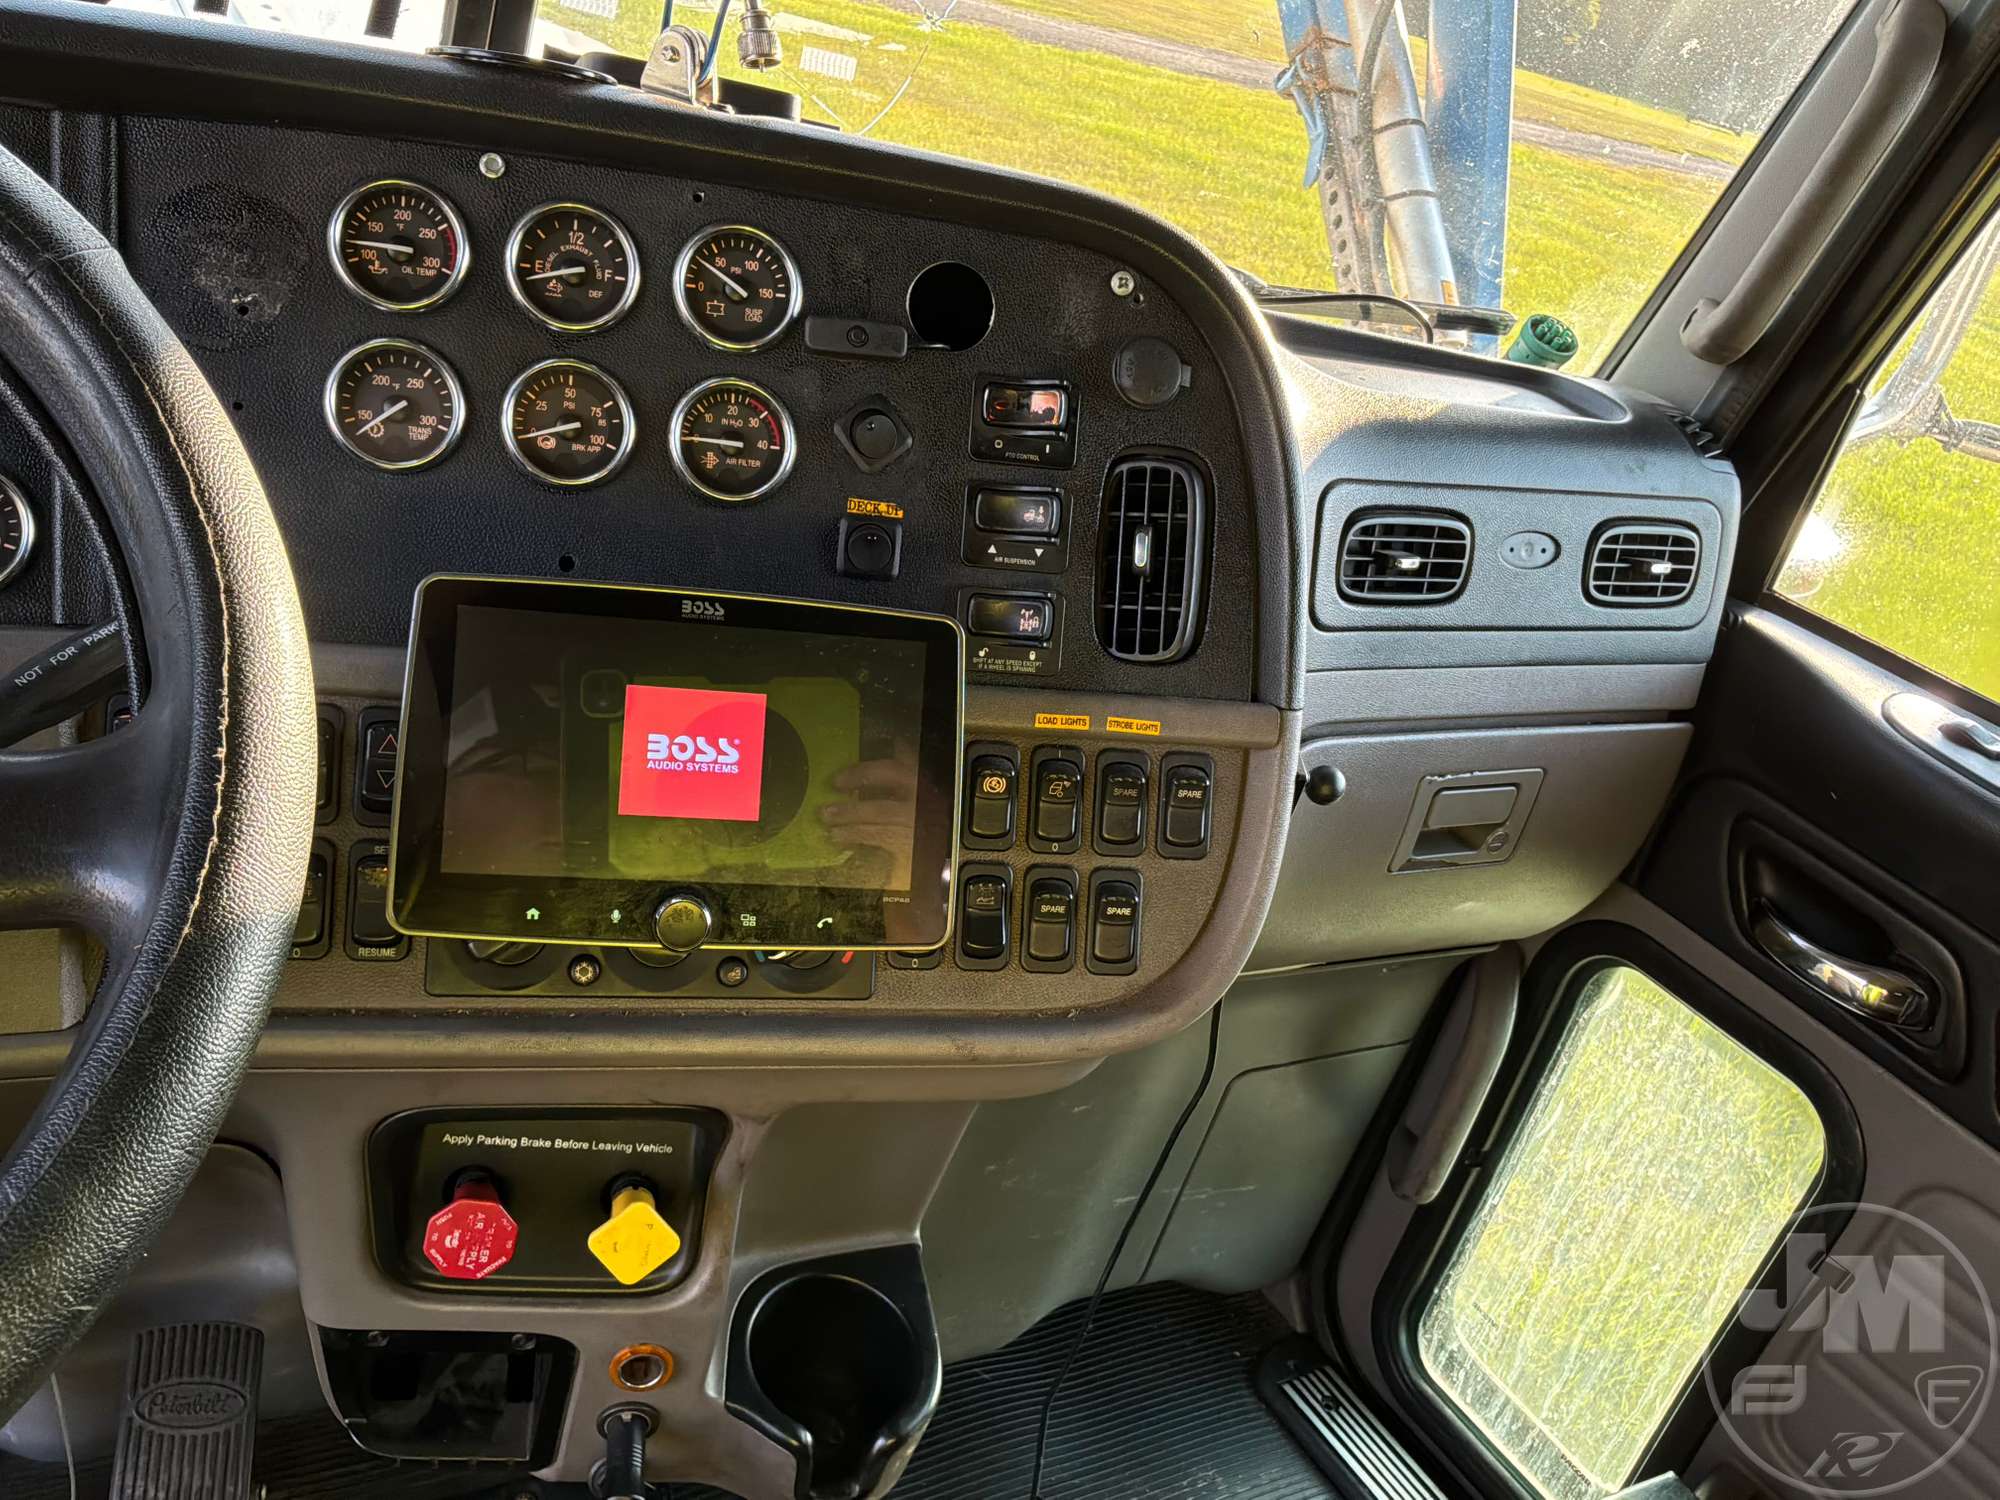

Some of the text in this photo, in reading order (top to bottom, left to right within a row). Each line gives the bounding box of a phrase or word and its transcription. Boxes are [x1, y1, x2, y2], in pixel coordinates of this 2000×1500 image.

[394, 209, 412, 220] 200
[368, 222, 384, 232] 150
[418, 228, 436, 240] 250
[568, 231, 584, 245] 1/2
[360, 250, 376, 260] 100
[560, 245, 593, 257] EXHAUST
[422, 257, 440, 268] 300
[535, 260, 544, 273] E
[715, 257, 726, 268] 50
[744, 260, 759, 272] 100
[402, 266, 437, 277] OIL TEMP
[730, 266, 742, 274] PSI
[604, 270, 613, 282] F
[698, 282, 704, 292] 0
[588, 290, 603, 298] DEF
[758, 288, 773, 299] 150
[372, 374, 390, 386] 200
[406, 378, 424, 389] 250
[564, 388, 576, 398] 50
[536, 400, 548, 411] 25
[564, 401, 576, 410] PSI
[728, 406, 738, 416] 20
[358, 410, 372, 420] 150
[590, 406, 602, 418] 75
[704, 412, 713, 422] 10
[419, 415, 437, 426] 300
[748, 417, 760, 428] 30
[408, 426, 432, 434] TRANS
[408, 432, 428, 440] TEMP
[590, 435, 605, 446] 100
[572, 444, 600, 453] BRK APP
[757, 440, 768, 450] 40
[1016, 453, 1040, 462] CONTROL
[738, 459, 760, 468] FILTER
[848, 500, 880, 514] DECK
[682, 600, 724, 616] BOSS
[14, 665, 42, 687] NOT
[49, 646, 78, 666] FOR
[1038, 716, 1087, 726] LOAD LIGHTS
[1108, 720, 1158, 732] STROBE LIGHTS
[647, 734, 740, 764] BOSS
[647, 760, 739, 774] AUDIO SYSTEMS
[1113, 788, 1138, 797] SPARE
[1178, 789, 1202, 798] SPARE
[1040, 904, 1066, 914] SPARE
[1106, 906, 1132, 916] SPARE
[358, 948, 396, 958] RESUME
[442, 1133, 673, 1154] Apply Parking Brake Before Leaving Vehicle
